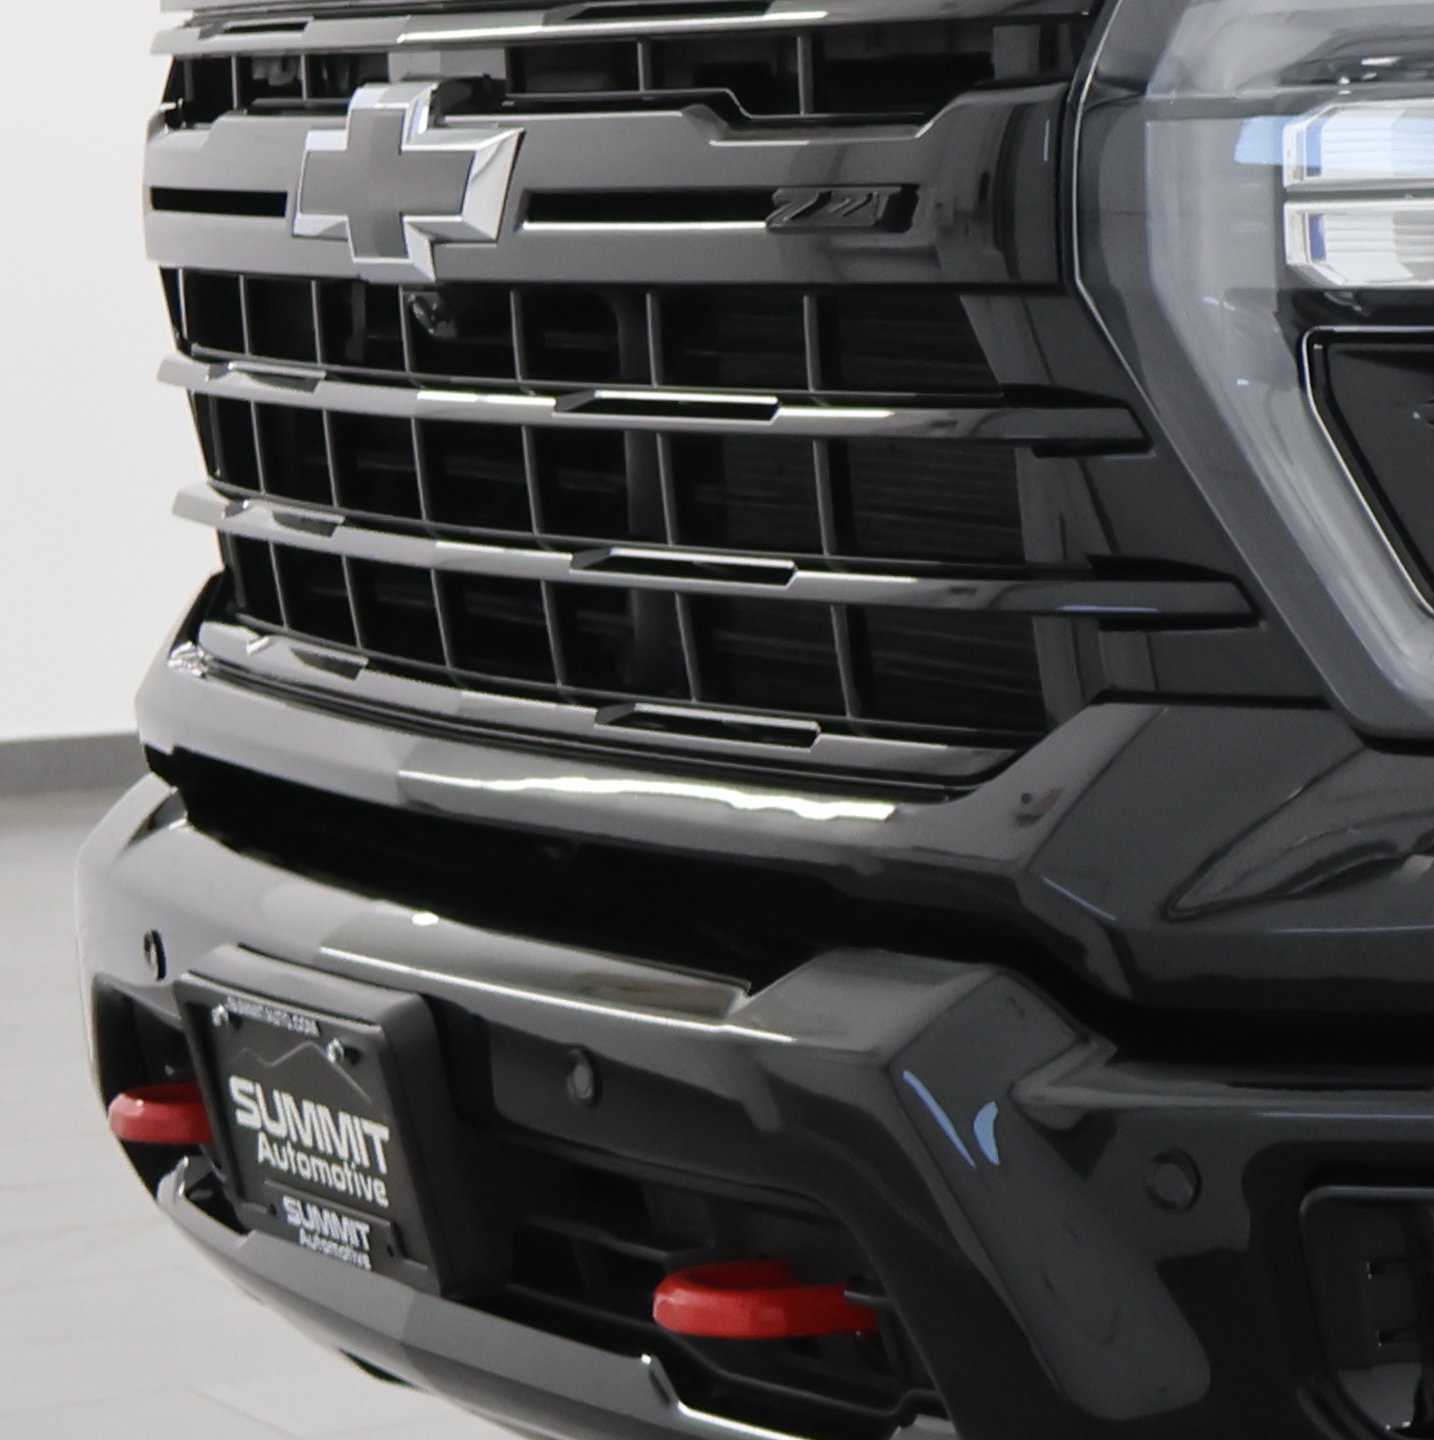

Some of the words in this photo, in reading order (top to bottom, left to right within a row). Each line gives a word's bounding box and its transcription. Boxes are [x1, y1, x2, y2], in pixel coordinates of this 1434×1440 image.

[229, 1074, 390, 1175] SUMMIT
[257, 1131, 390, 1209] Automotive
[283, 1195, 371, 1252] SUMMIT
